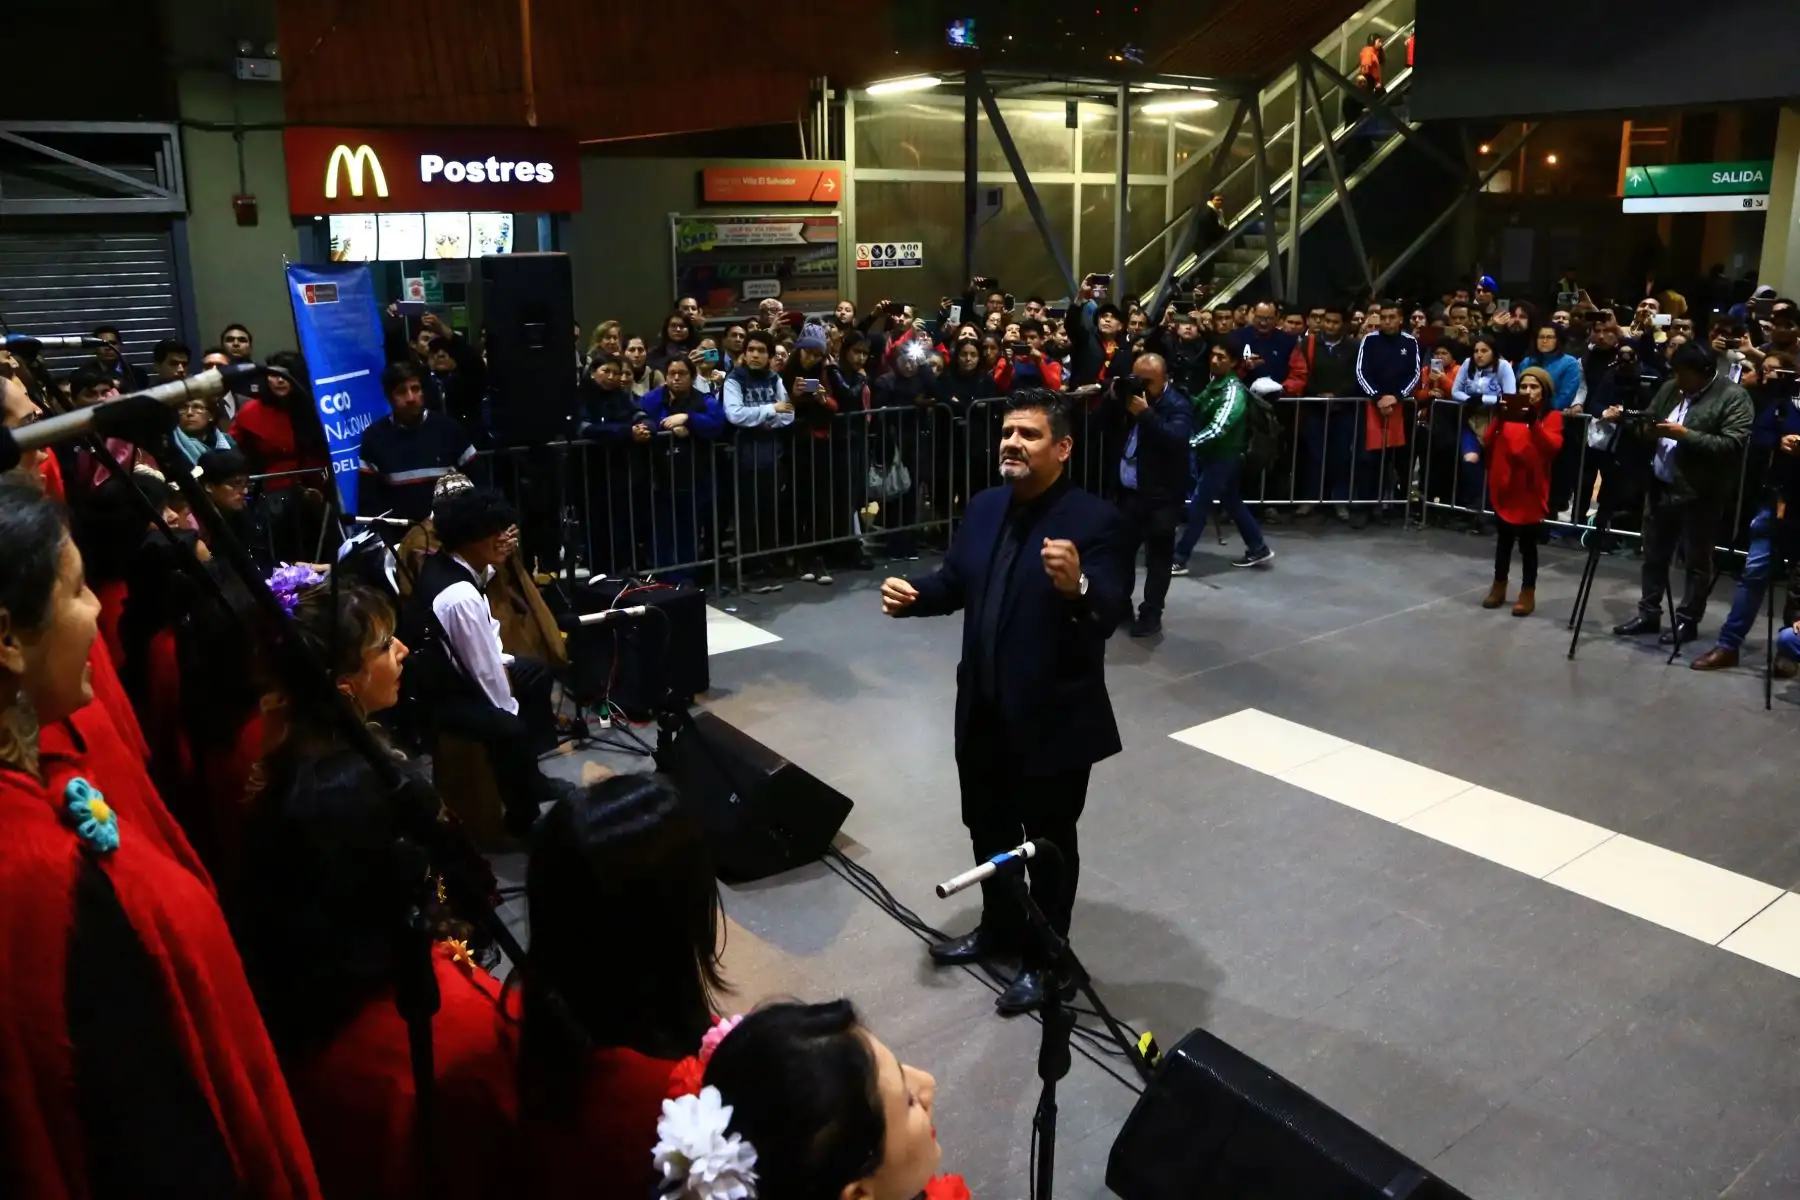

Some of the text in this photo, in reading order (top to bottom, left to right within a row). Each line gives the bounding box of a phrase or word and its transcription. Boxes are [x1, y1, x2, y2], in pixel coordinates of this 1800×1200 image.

[420, 154, 554, 184] Postres
[1711, 170, 1764, 184] SALIDA
[332, 457, 359, 475] DEL
